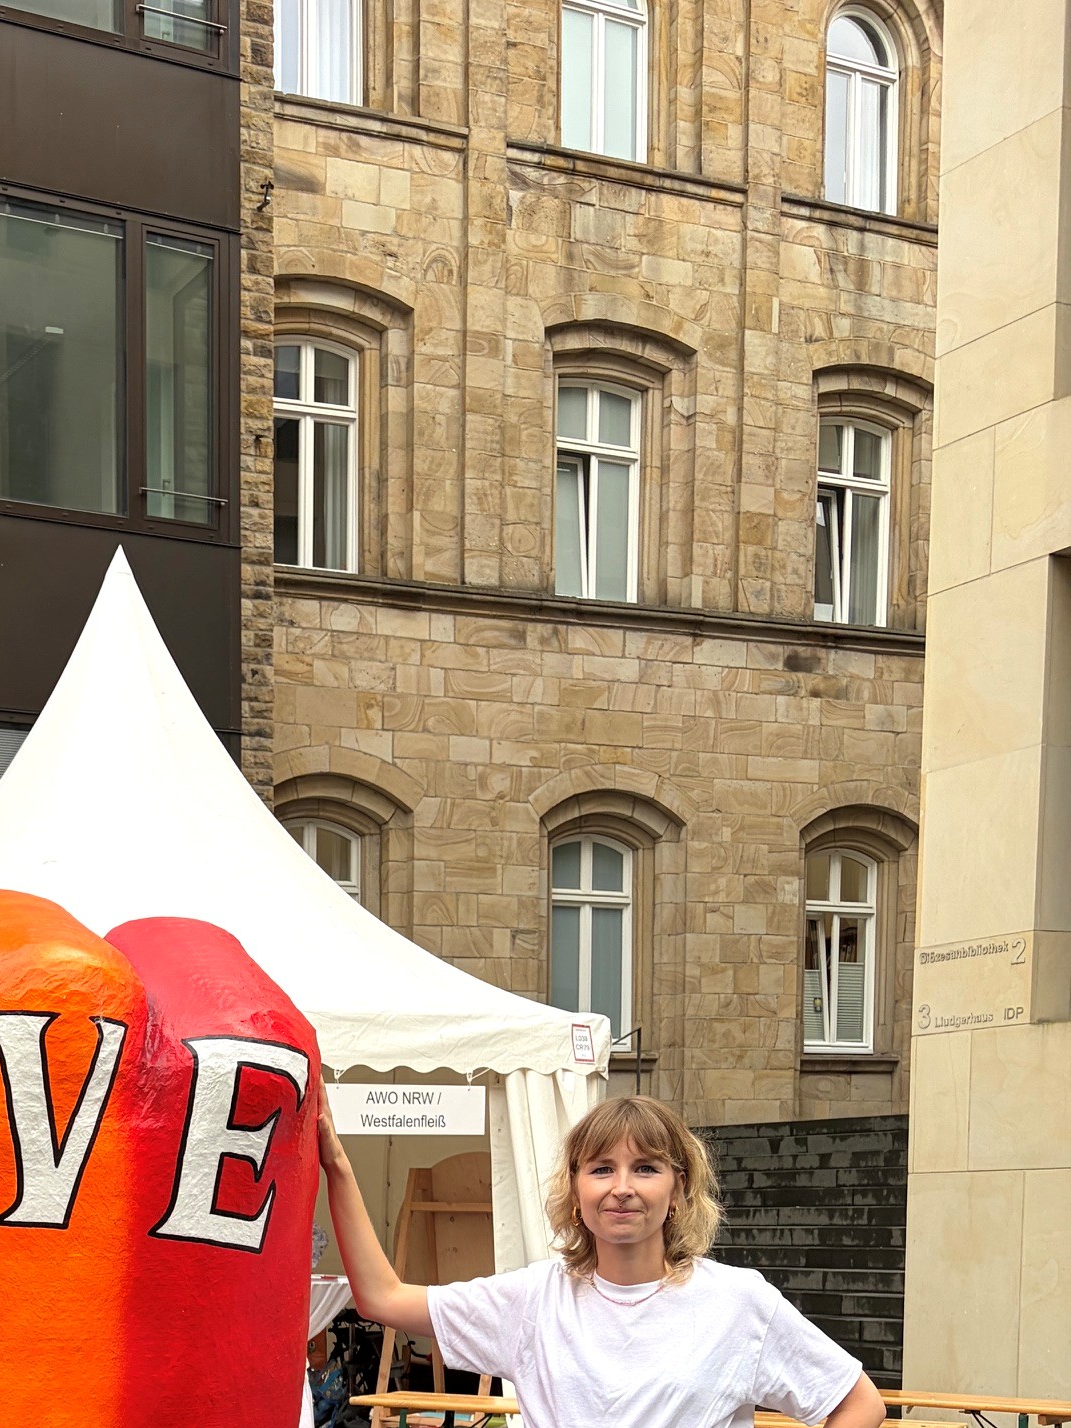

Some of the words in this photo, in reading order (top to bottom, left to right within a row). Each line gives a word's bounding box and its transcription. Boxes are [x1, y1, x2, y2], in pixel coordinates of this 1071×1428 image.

[1010, 937, 1027, 966] 2
[917, 1003, 932, 1030] 3
[1003, 1006, 1025, 1021] IDP
[365, 1091, 399, 1105] AWO
[402, 1091, 435, 1105] NRW
[436, 1092, 442, 1105] /
[360, 1114, 447, 1128] Westfalenfleiß
